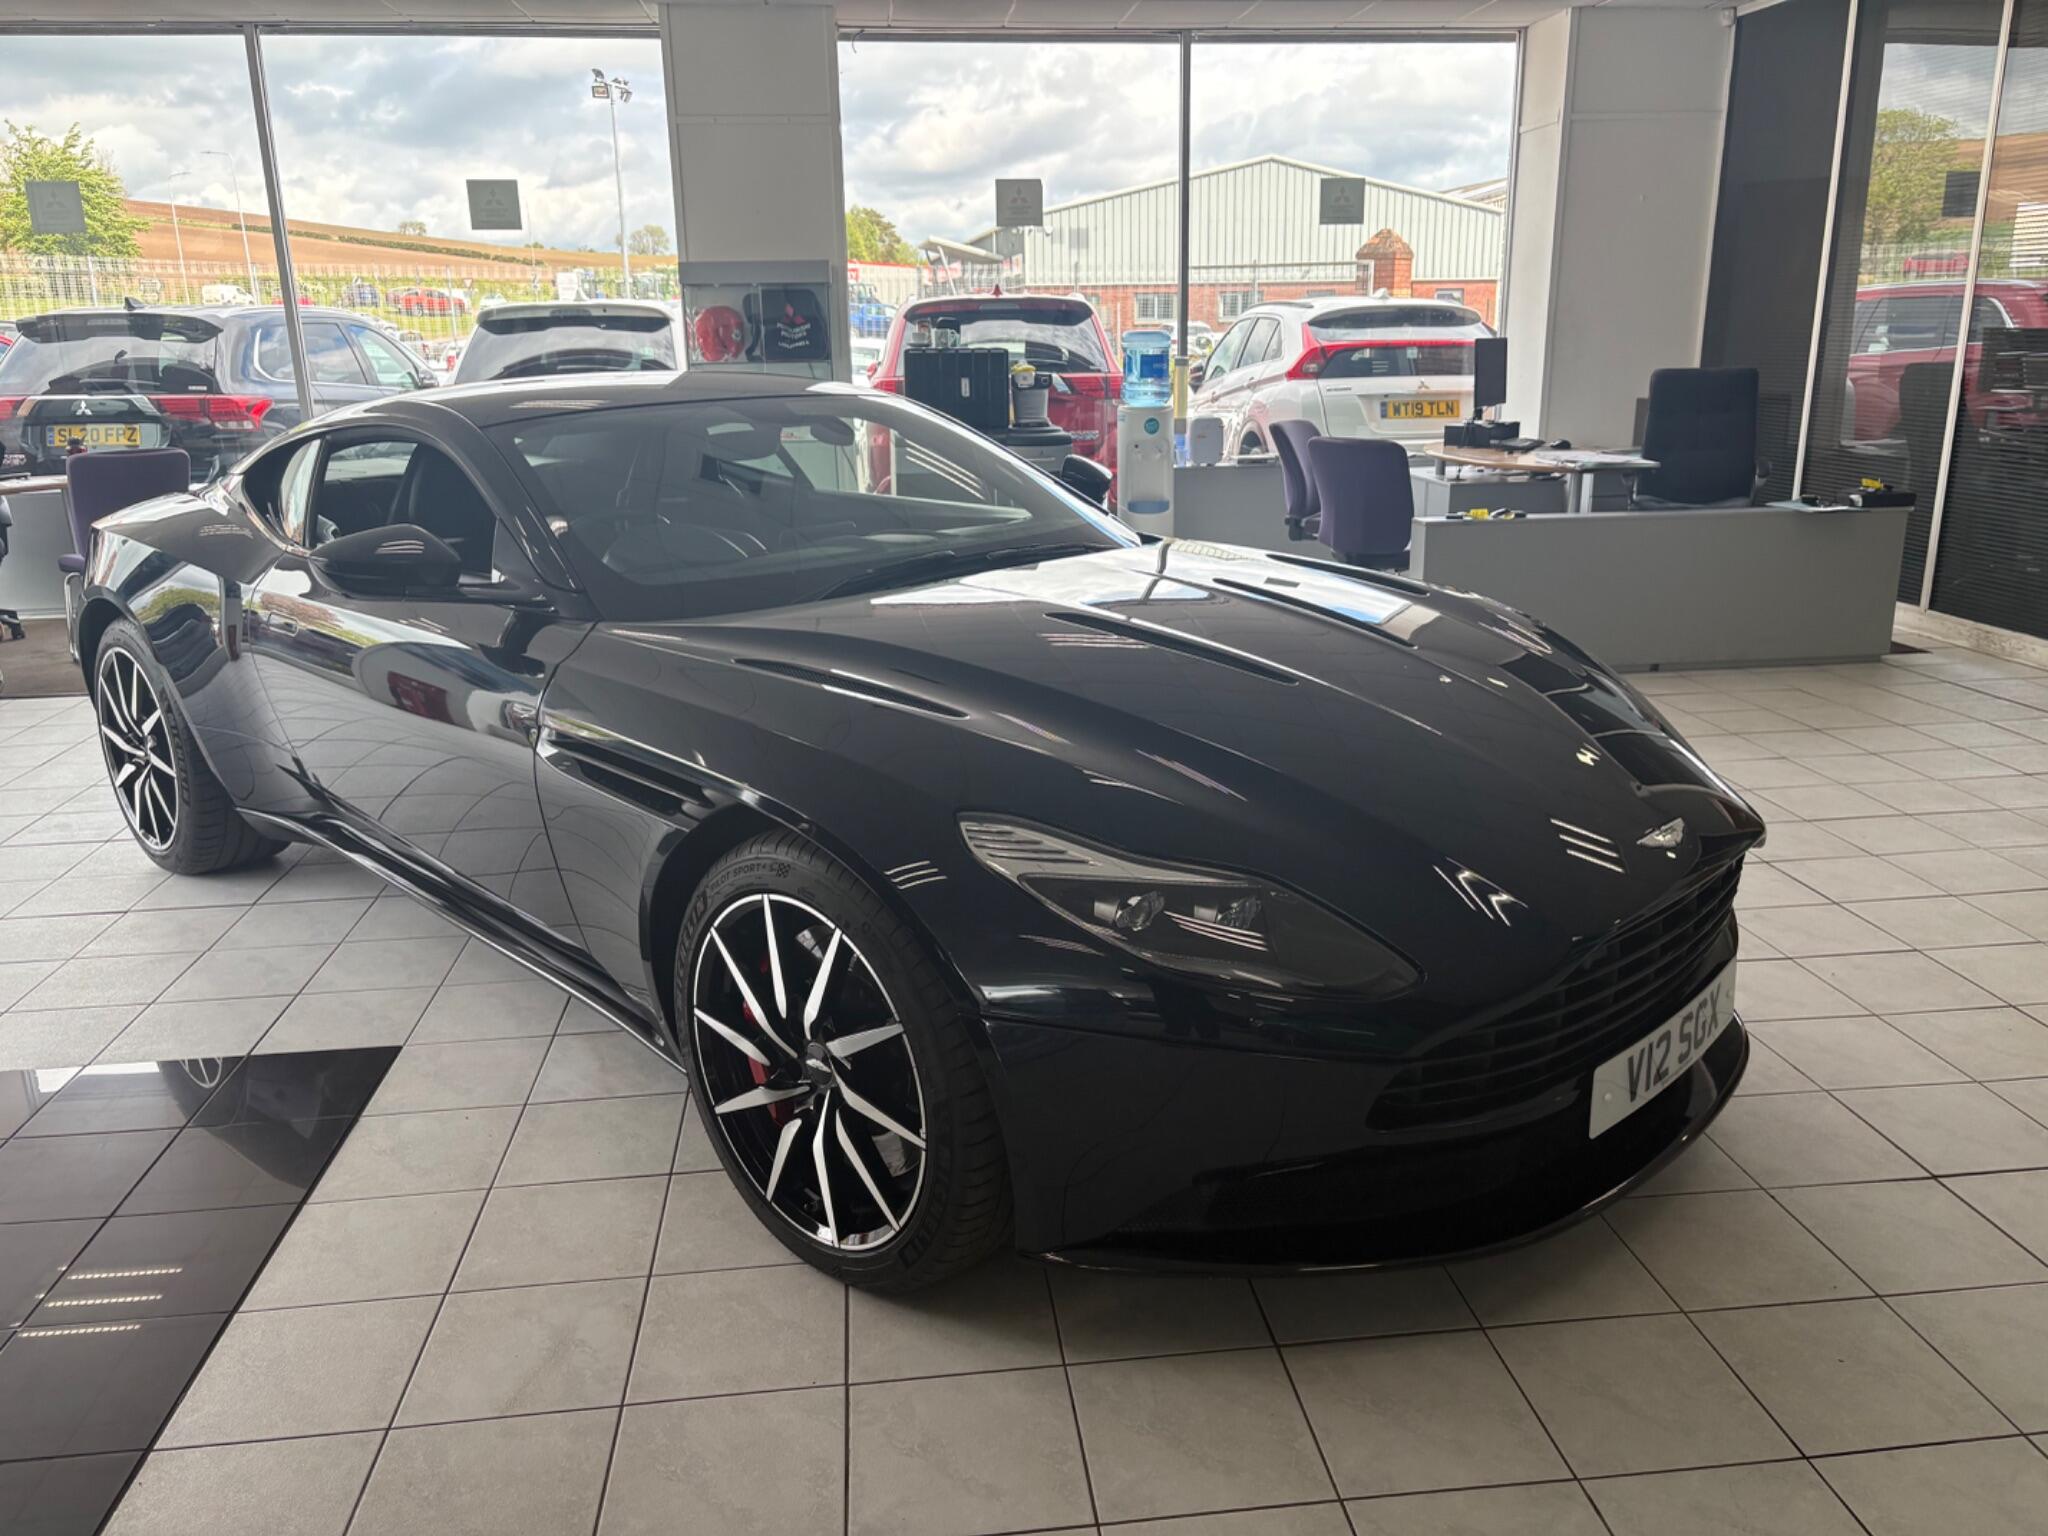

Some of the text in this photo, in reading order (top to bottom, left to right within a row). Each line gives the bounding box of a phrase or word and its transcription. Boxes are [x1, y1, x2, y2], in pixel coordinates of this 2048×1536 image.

[1392, 400, 1455, 416] WT19 TLN
[1627, 982, 1721, 1103] V12 SGX
